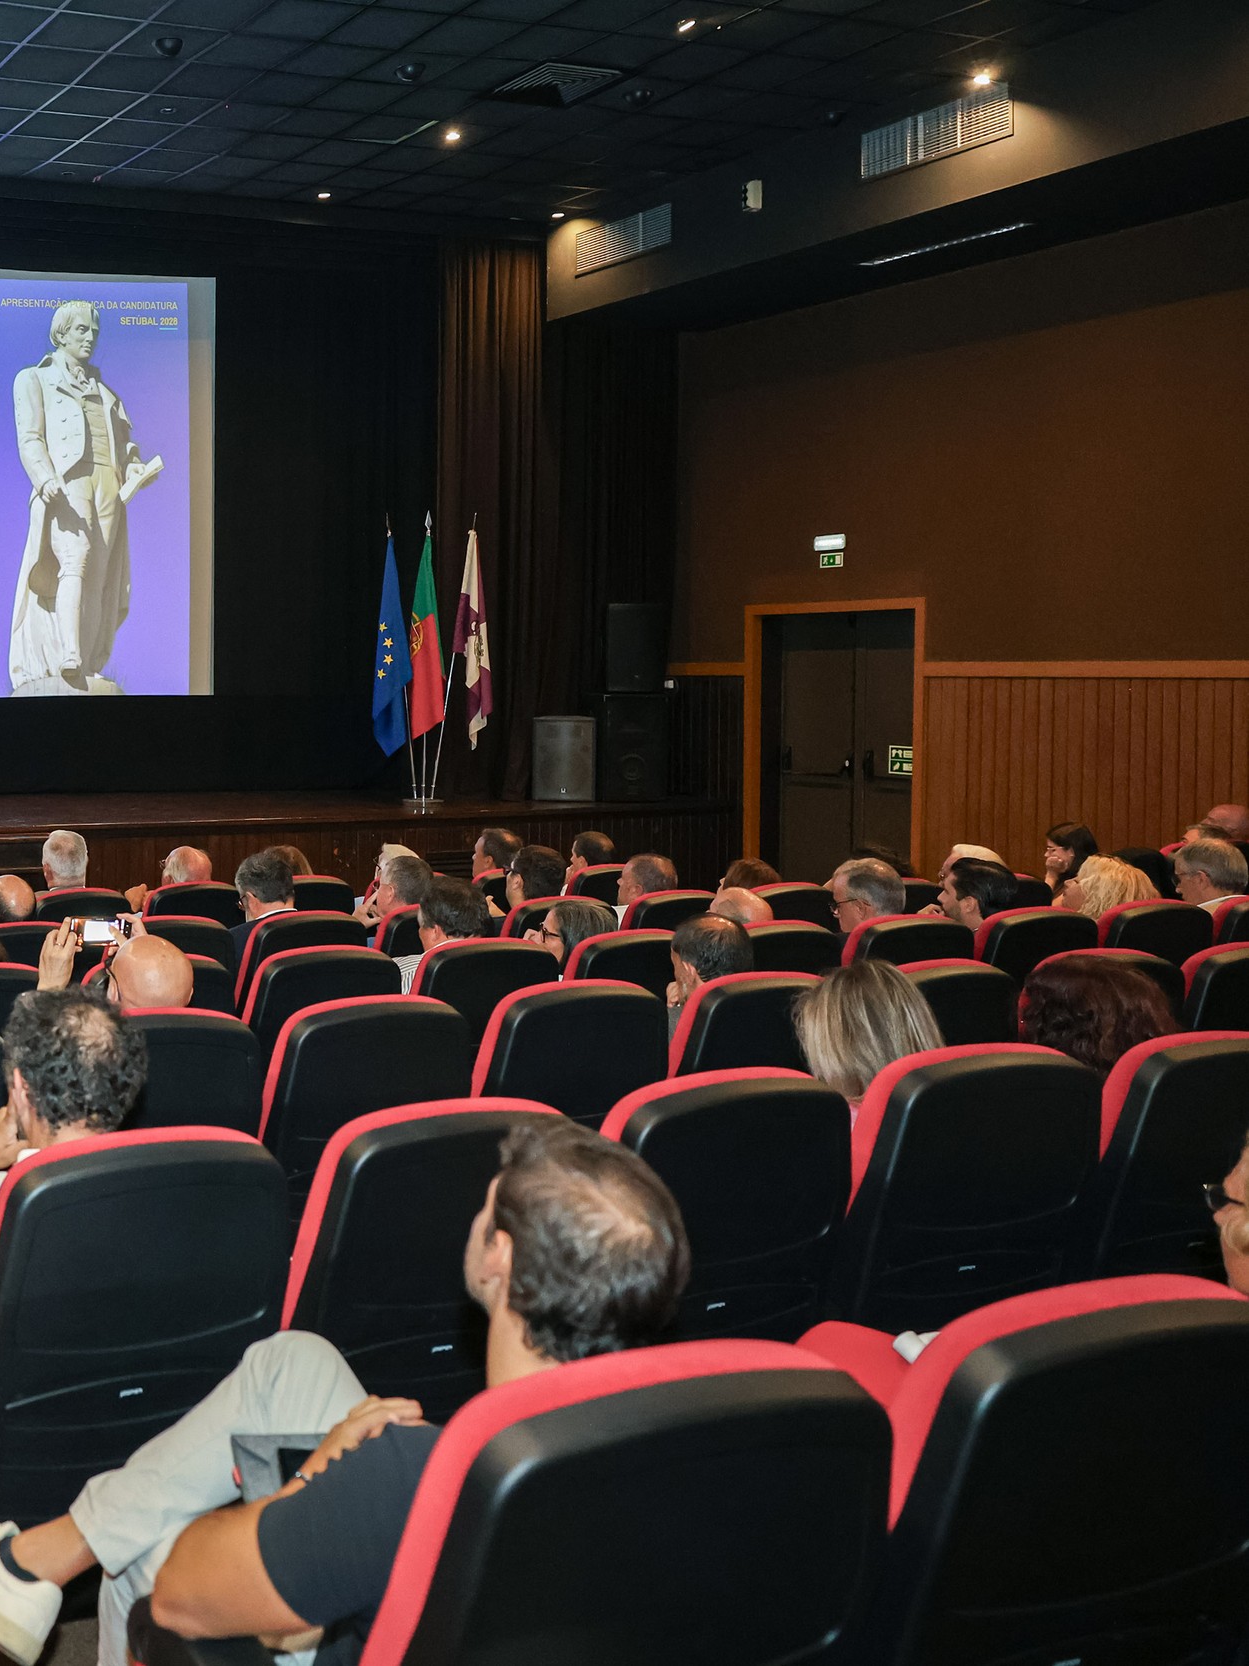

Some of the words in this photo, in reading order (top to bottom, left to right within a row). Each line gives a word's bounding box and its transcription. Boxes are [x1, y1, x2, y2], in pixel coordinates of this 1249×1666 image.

[107, 301, 119, 309] DA
[120, 301, 178, 310] CANDIDATURA
[120, 315, 158, 325] SETÚBAL
